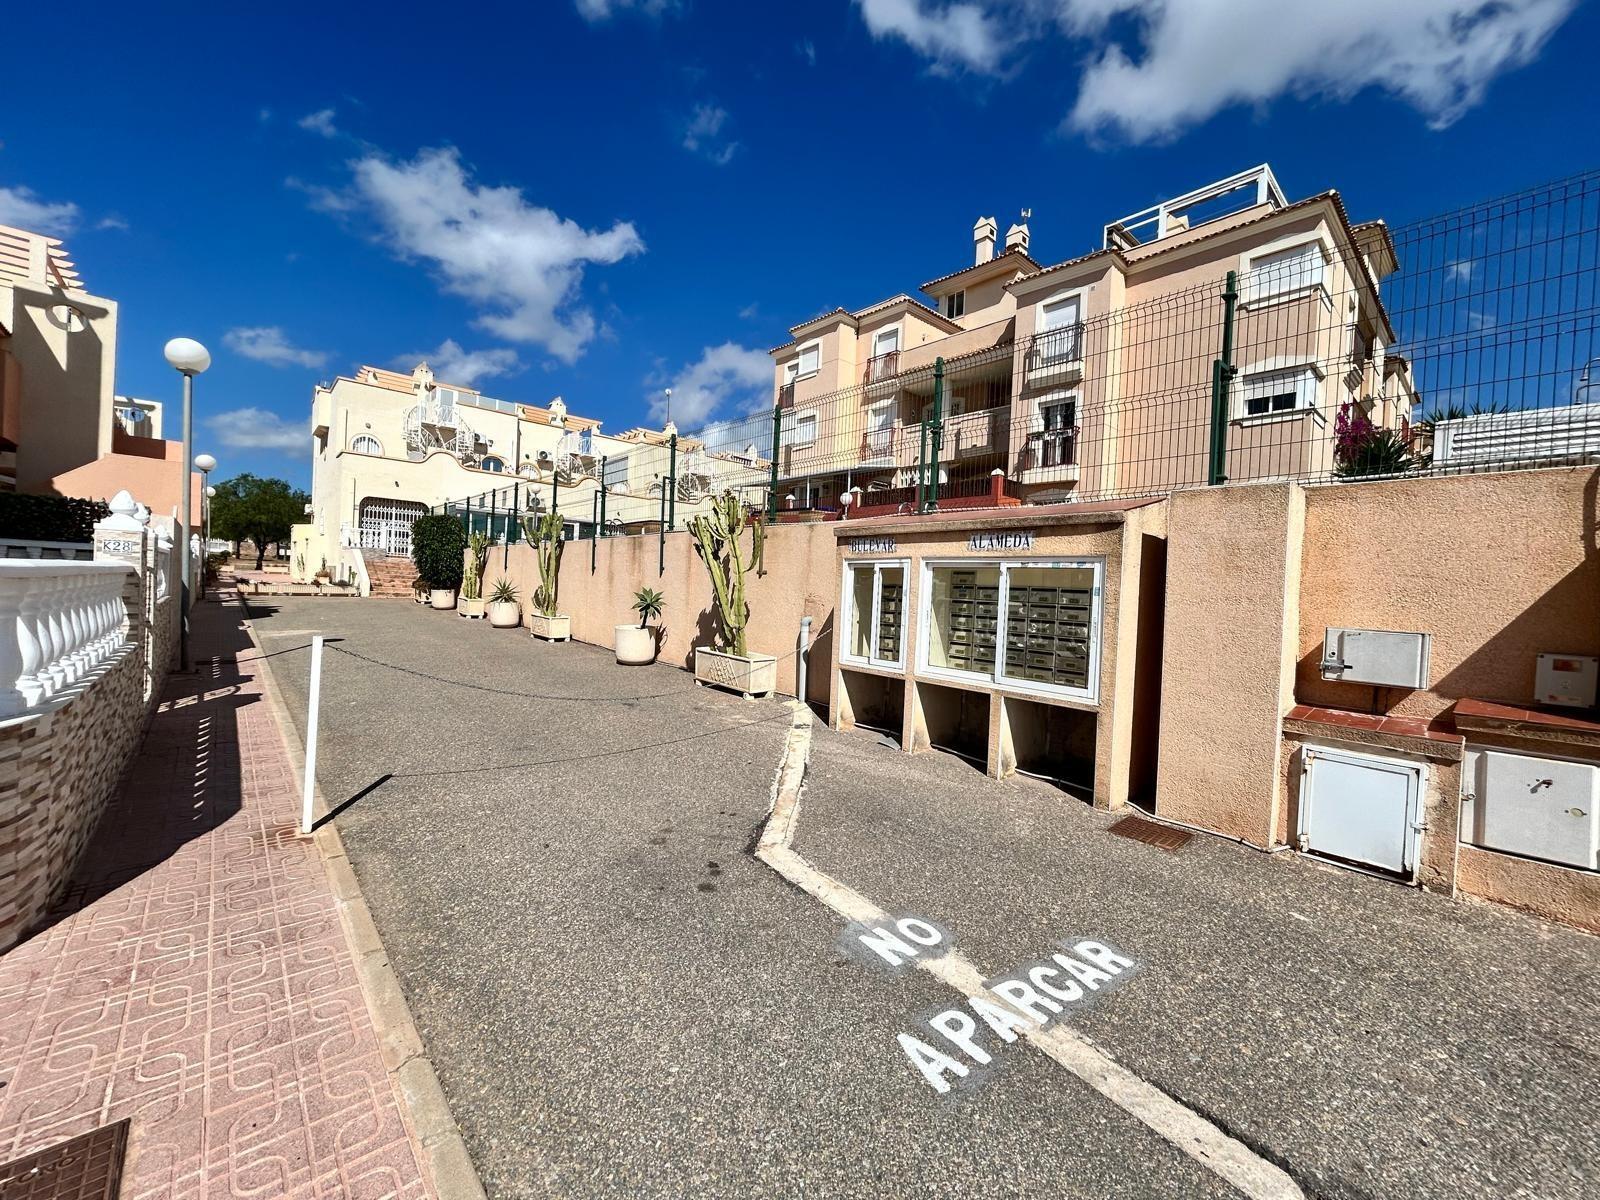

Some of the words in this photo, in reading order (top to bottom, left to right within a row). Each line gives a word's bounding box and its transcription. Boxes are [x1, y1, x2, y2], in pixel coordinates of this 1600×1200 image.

[103, 541, 131, 551] K28
[851, 539, 895, 552] BULEVAR
[970, 533, 1031, 549] ALAMEDA
[859, 918, 942, 967] NO
[897, 941, 1135, 1094] APARCAR
